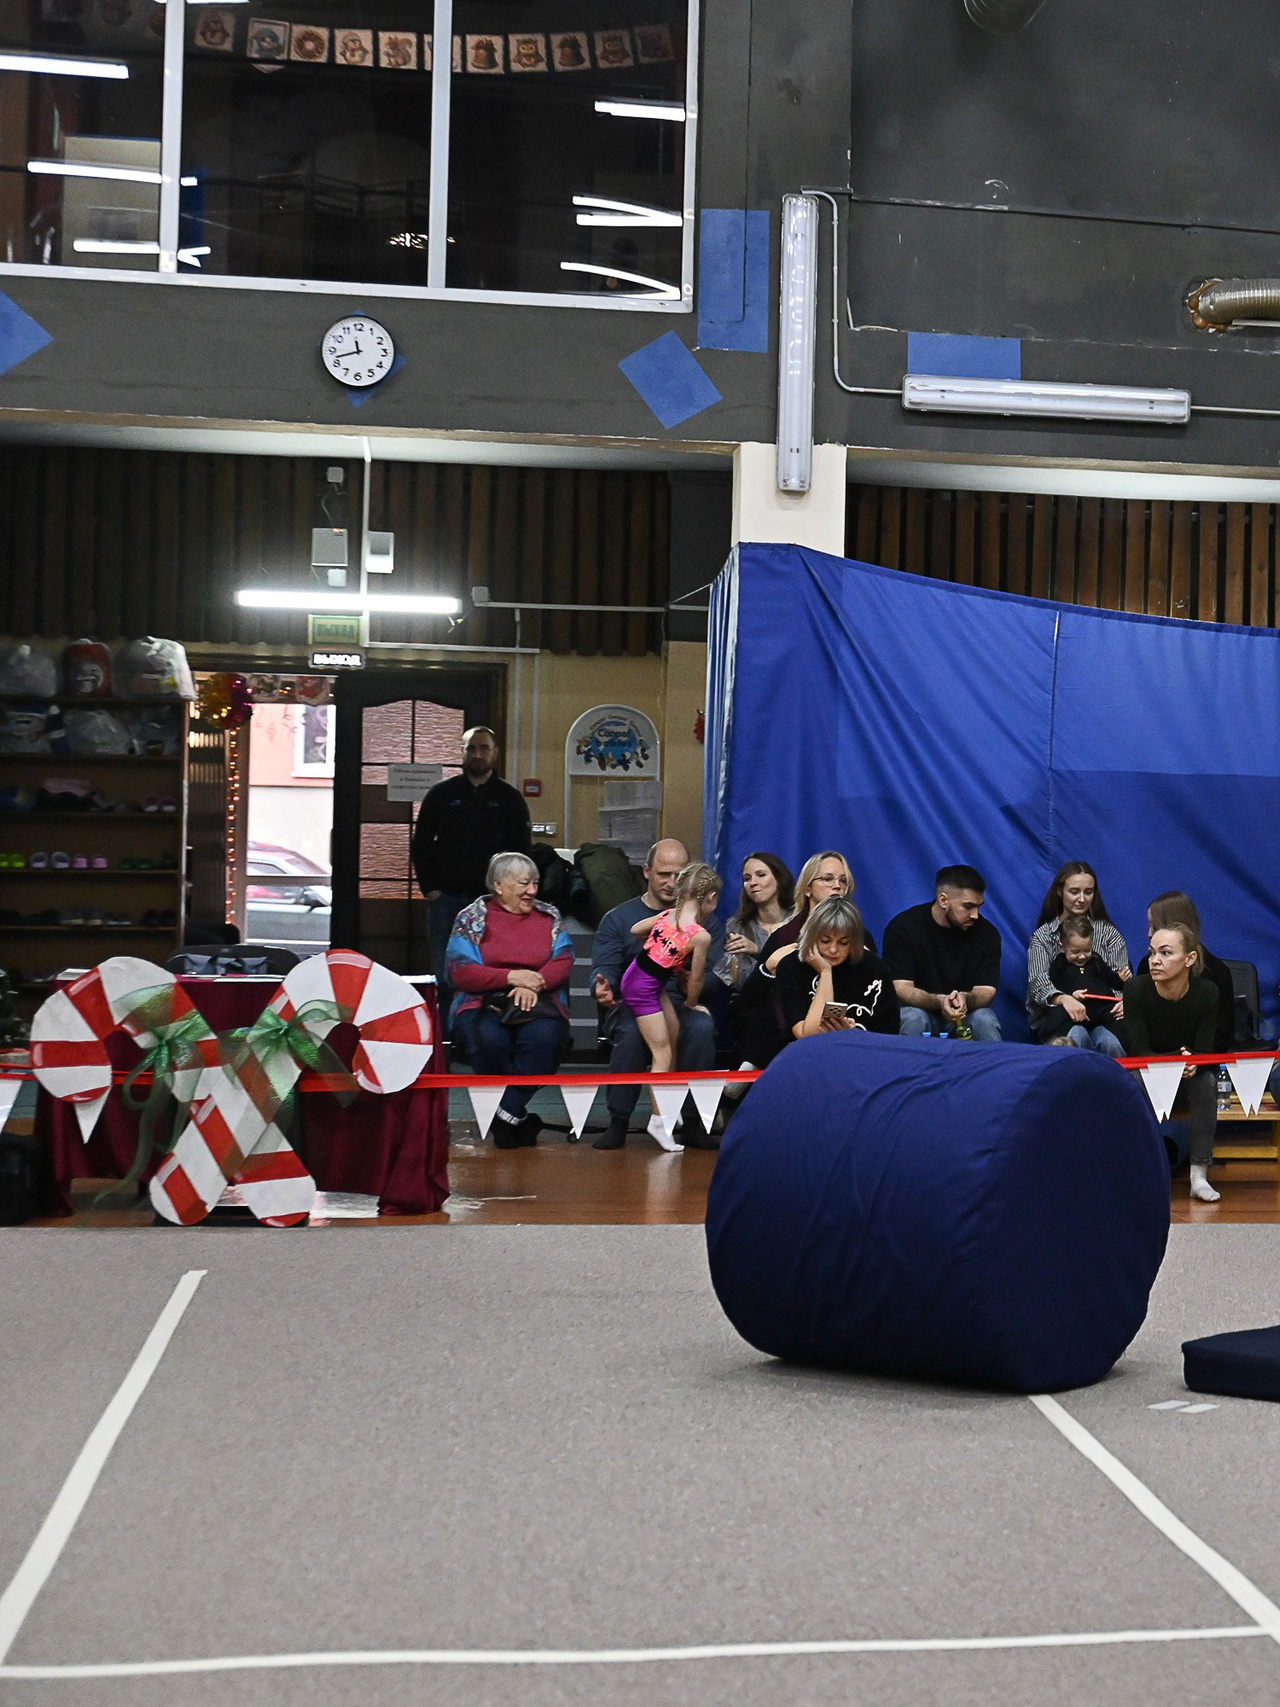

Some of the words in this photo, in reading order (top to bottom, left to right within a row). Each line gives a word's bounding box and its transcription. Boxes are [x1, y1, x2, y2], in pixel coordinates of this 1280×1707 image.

[342, 326, 351, 335] 11
[353, 323, 364, 332] 12
[376, 336, 384, 345] 2
[328, 346, 337, 355] 9
[380, 348, 388, 357] 3
[333, 359, 341, 368] 8
[376, 361, 384, 369] 4
[343, 367, 350, 377] 7
[353, 372, 362, 381] 6
[367, 368, 375, 378] 5
